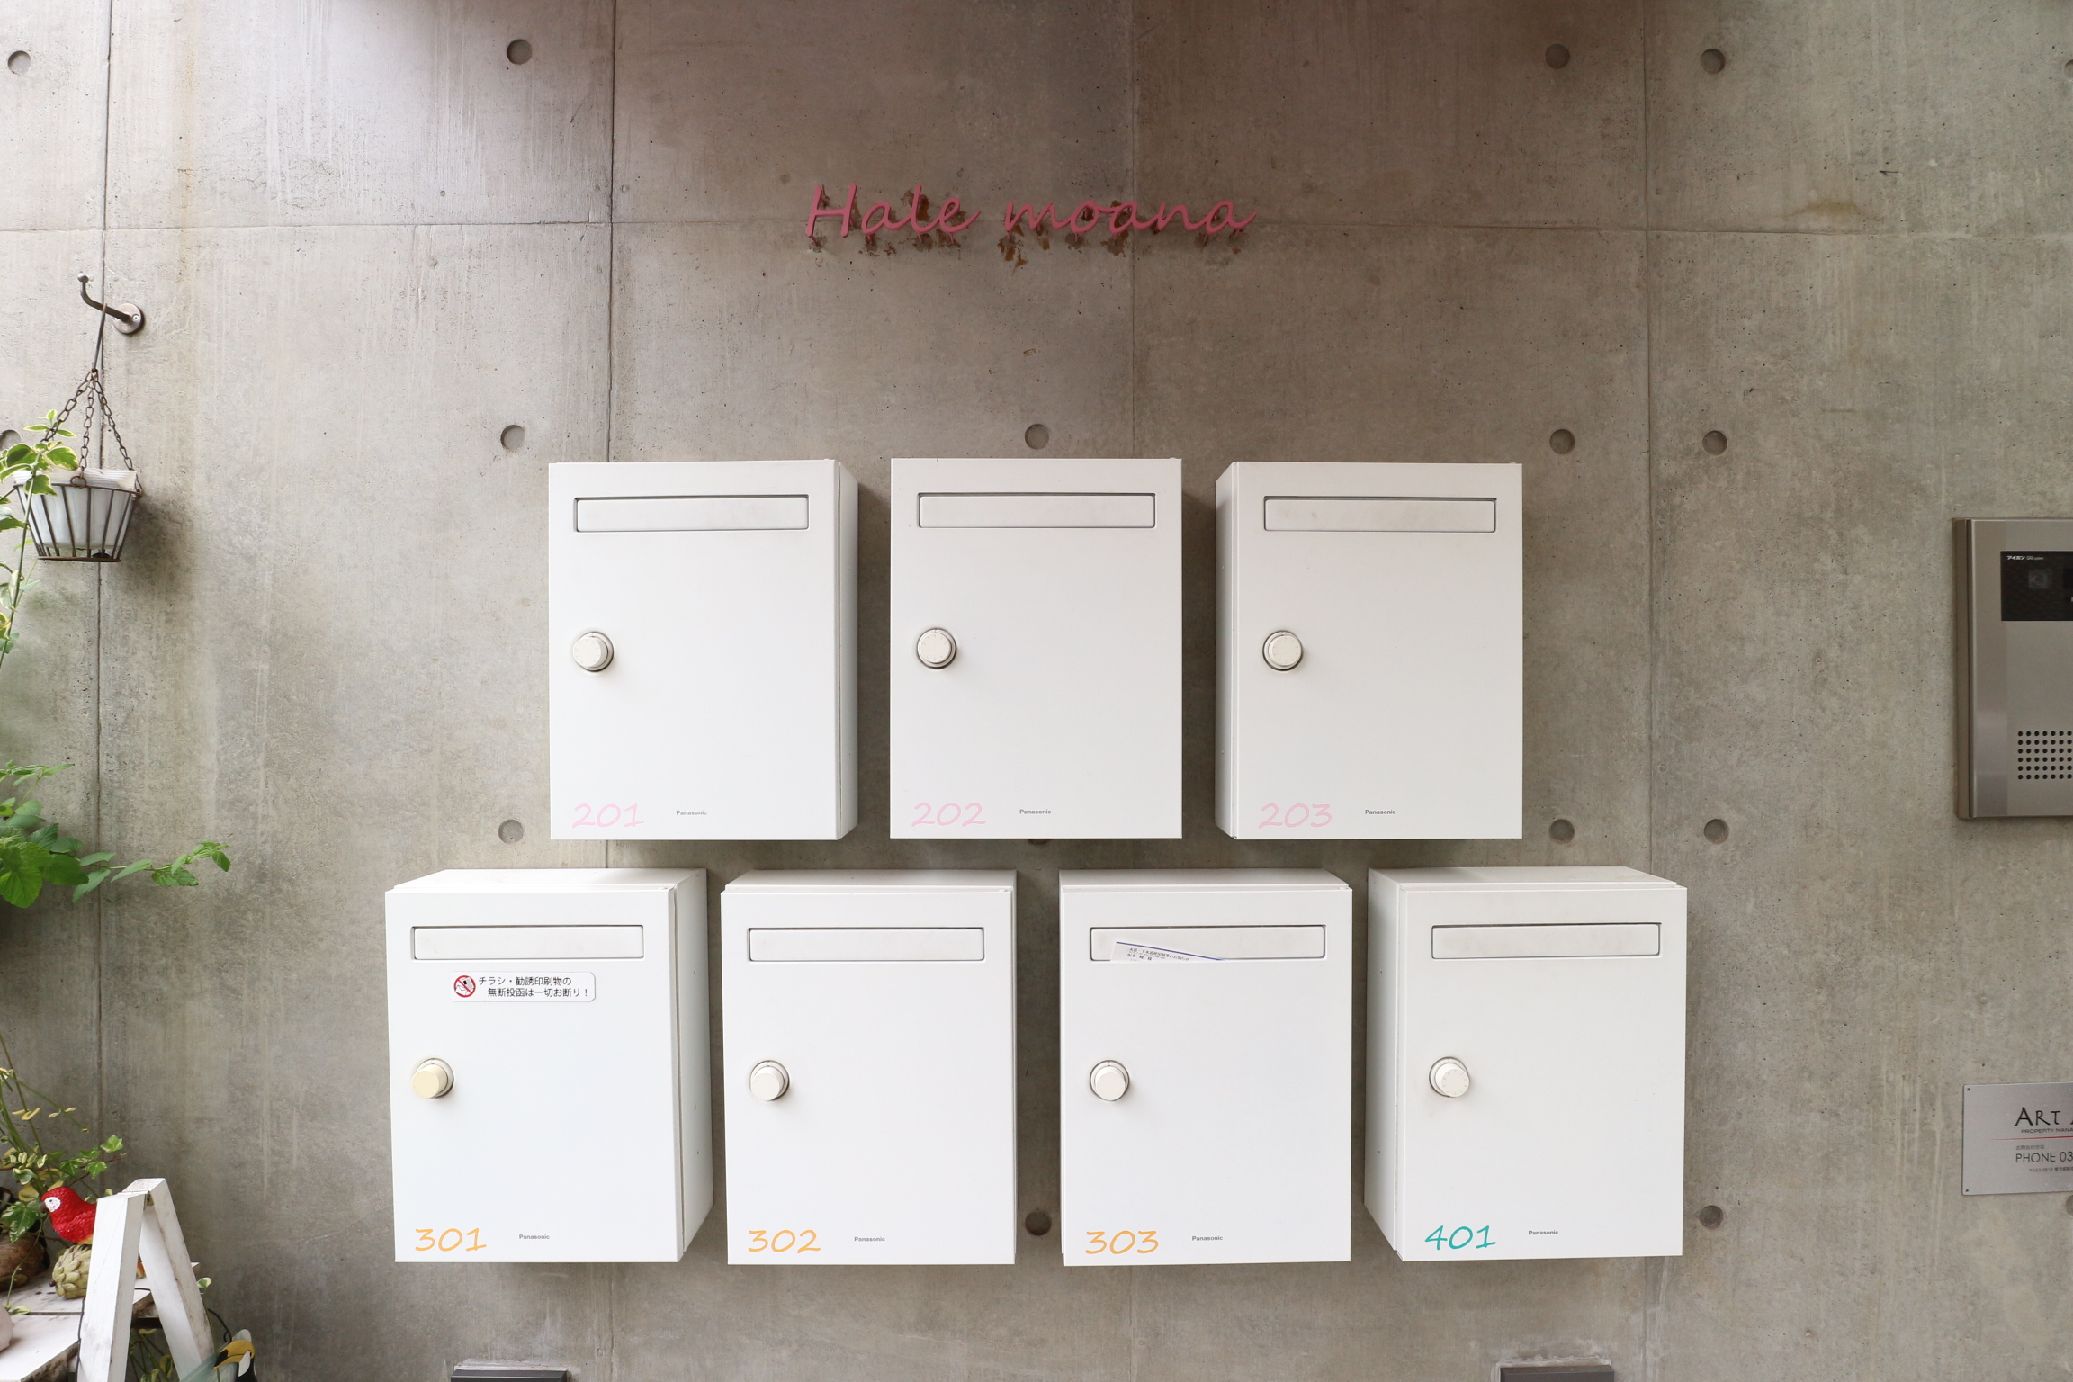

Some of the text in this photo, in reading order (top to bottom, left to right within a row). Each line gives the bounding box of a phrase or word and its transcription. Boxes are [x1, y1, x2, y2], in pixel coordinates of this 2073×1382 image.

[1004, 199, 1257, 236] moana
[571, 802, 645, 829] 201
[911, 802, 986, 827] 202
[1259, 802, 1332, 829] 203
[2014, 1107, 2061, 1126] ART
[2015, 1152, 2056, 1163] PHONE
[415, 1227, 487, 1252] 301
[748, 1229, 822, 1253] 302
[1085, 1230, 1159, 1254] 303
[1424, 1225, 1496, 1250] 401
